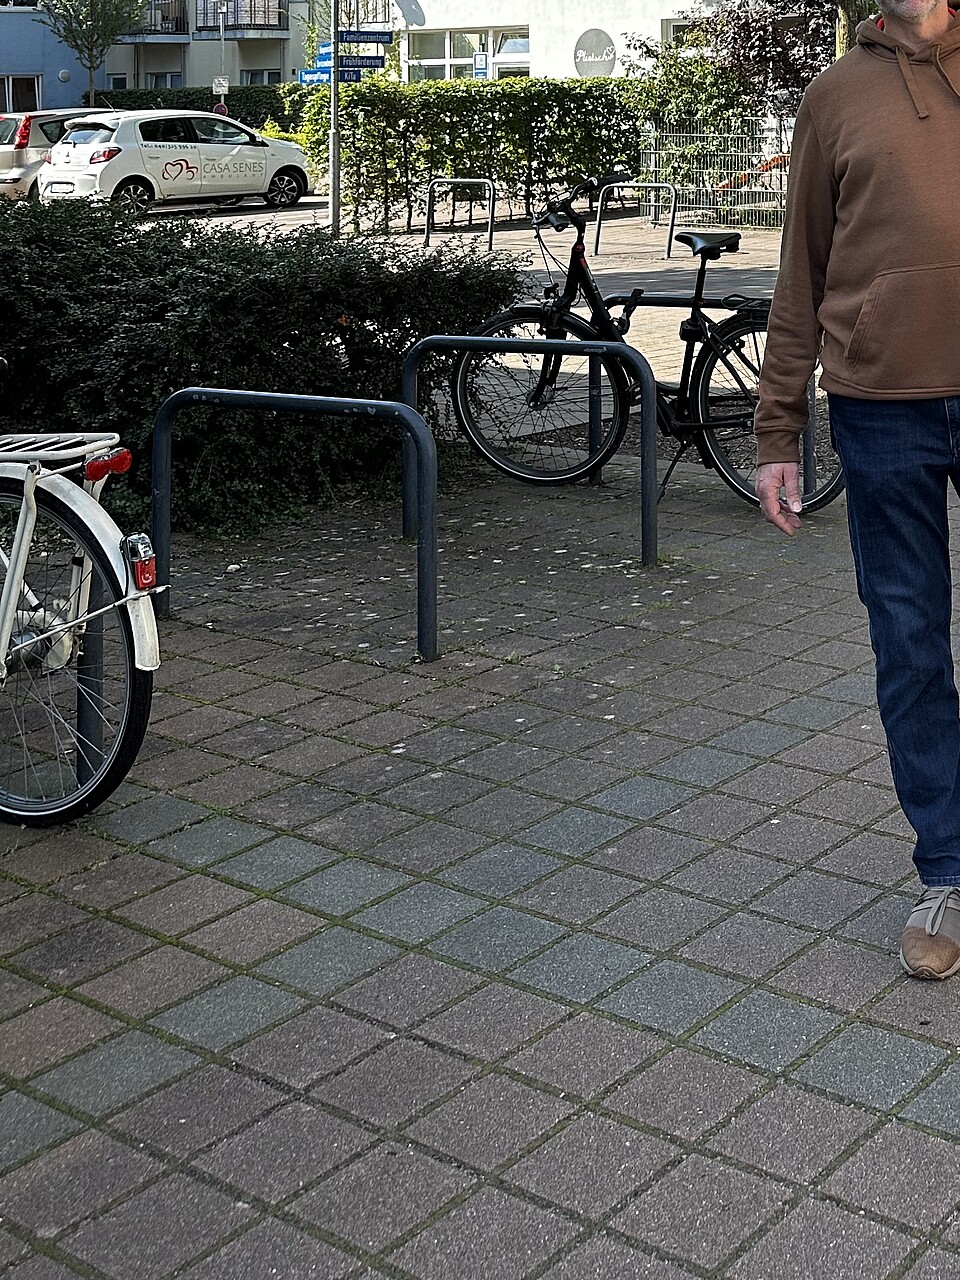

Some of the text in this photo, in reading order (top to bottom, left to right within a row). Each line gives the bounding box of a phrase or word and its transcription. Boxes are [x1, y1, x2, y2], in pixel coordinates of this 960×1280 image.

[343, 33, 390, 42] Familienzentrum
[343, 57, 382, 67] Frühförderung
[301, 72, 329, 82] Tagespflege
[344, 72, 357, 81] KiTa
[203, 162, 264, 174] CASA SENES
